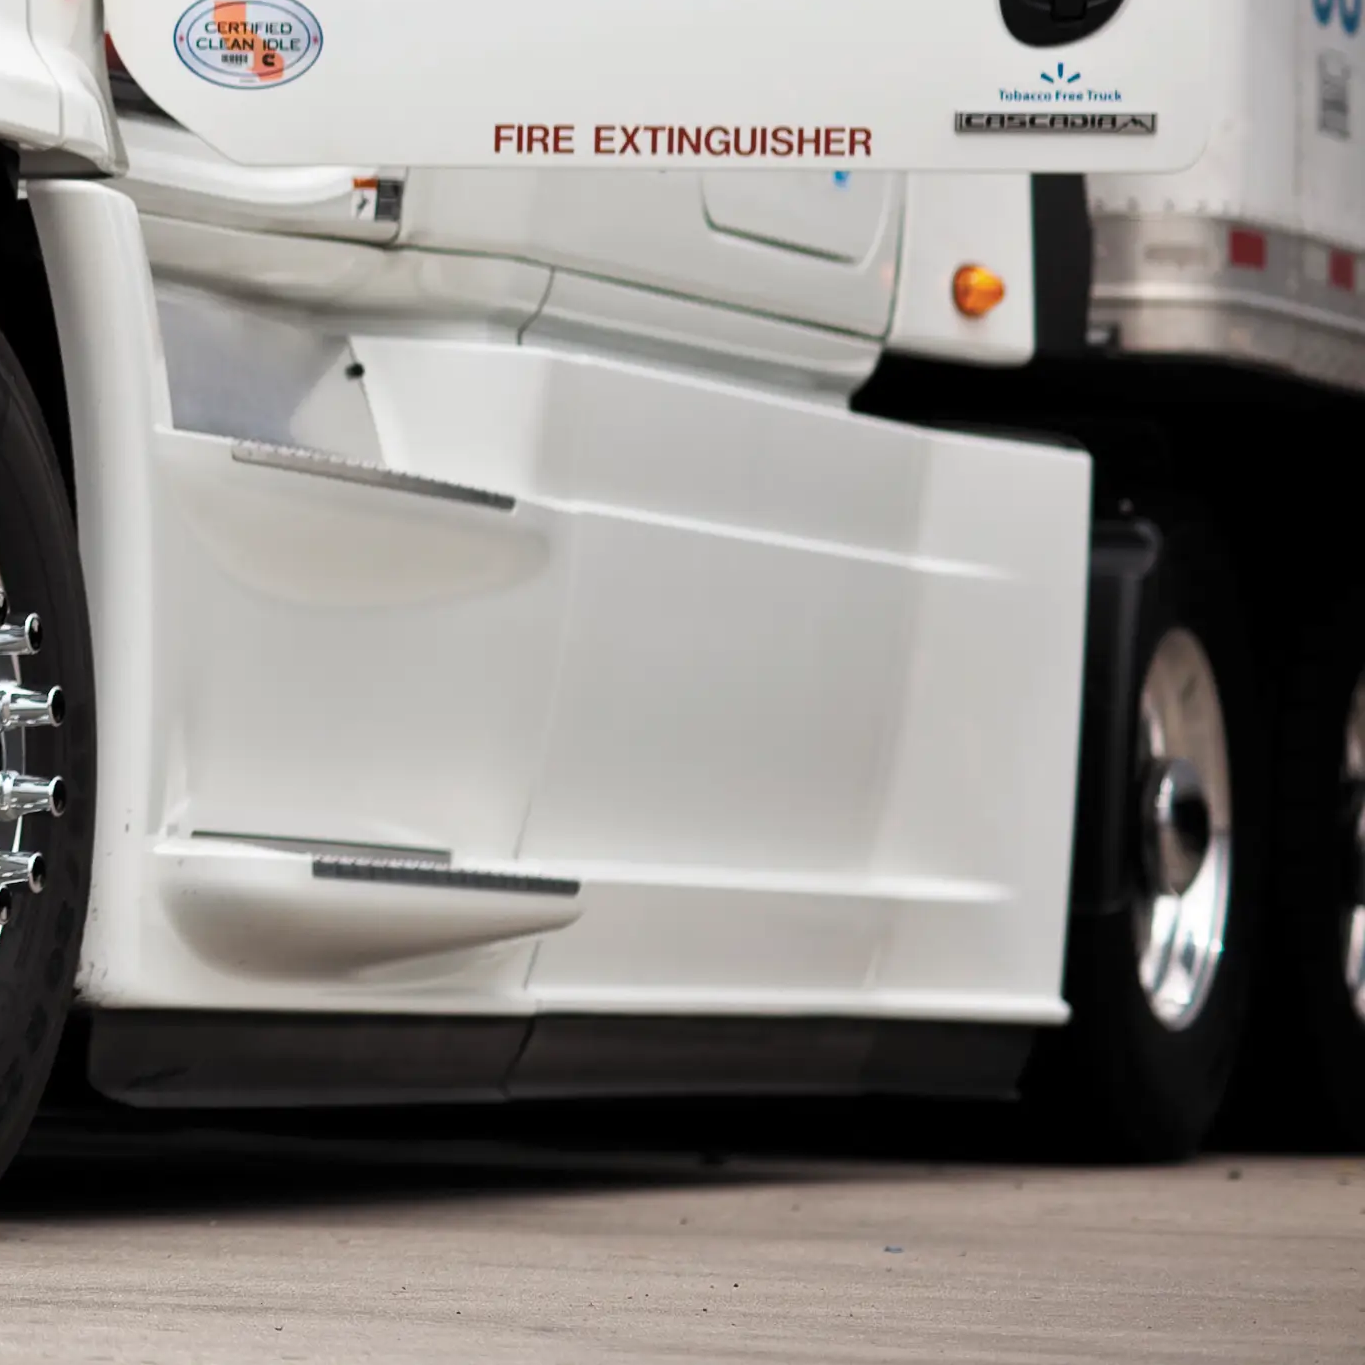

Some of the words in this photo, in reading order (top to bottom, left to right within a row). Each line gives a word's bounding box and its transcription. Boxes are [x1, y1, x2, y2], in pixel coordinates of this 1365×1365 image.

[204, 21, 293, 35] CERTIFIED
[196, 37, 254, 51] CLEAN
[262, 38, 301, 51] IDLE
[998, 89, 1052, 102] Tobacco
[1055, 89, 1084, 102] Free
[1087, 89, 1122, 102] Truck
[965, 113, 1117, 129] CASCADIA
[493, 123, 574, 155] FIRE
[594, 124, 872, 158] EXTINGUISHER
